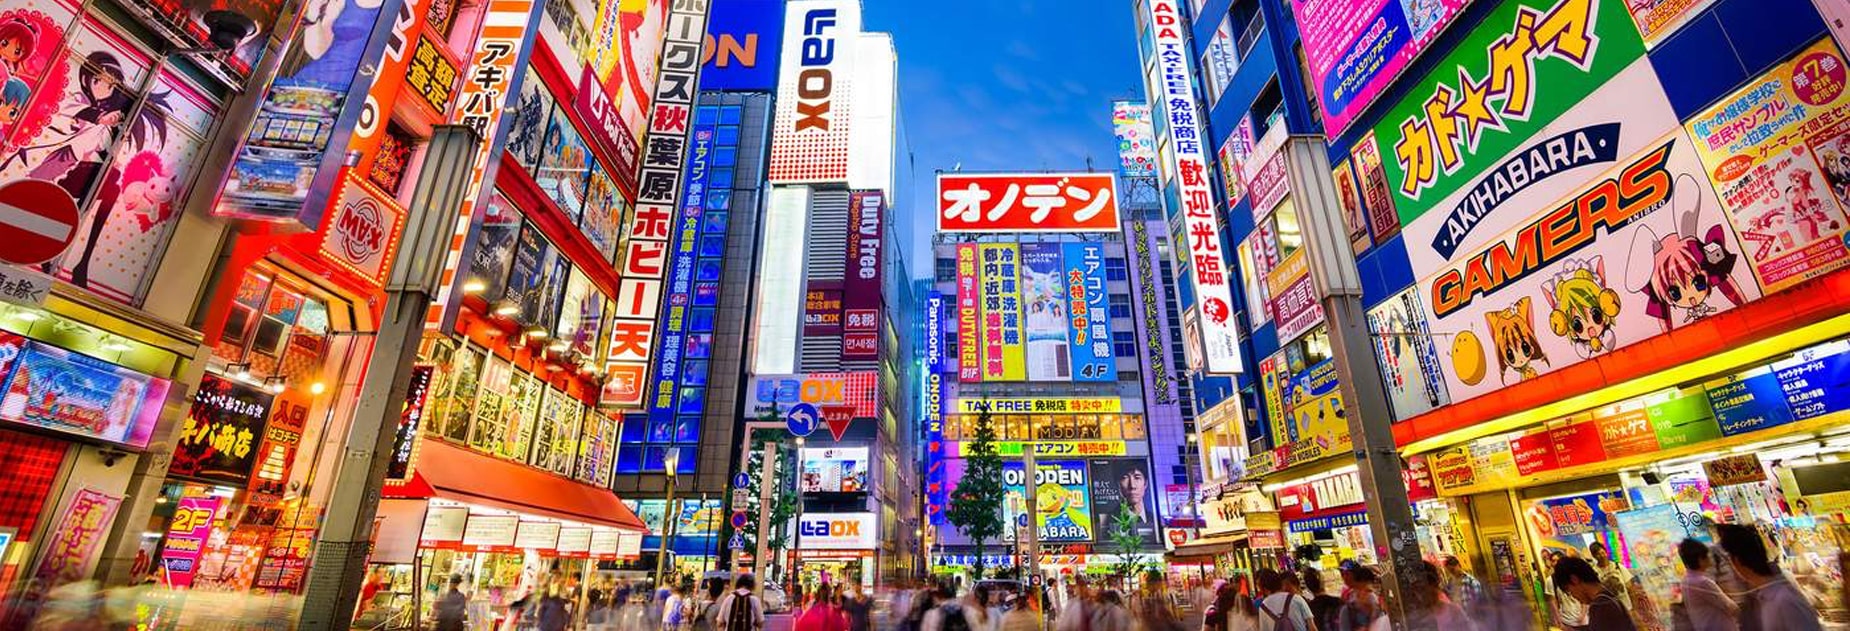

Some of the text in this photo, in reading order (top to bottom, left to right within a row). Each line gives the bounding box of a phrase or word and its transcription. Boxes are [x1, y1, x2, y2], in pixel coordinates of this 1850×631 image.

[1170, 98, 1199, 155] 免税商店
[943, 177, 1111, 224] オノデン
[1449, 131, 1596, 246] AKIHABARA
[859, 196, 882, 279] Duty Free
[1180, 159, 1224, 287] 歓迎光臨
[1431, 140, 1676, 316] GAMERS
[930, 298, 941, 365] Panasonic
[1081, 364, 1108, 378] 4F
[273, 400, 307, 429] 入口
[931, 373, 940, 432] ONODEN
[965, 401, 992, 411] TAX
[996, 401, 1032, 411] FREE
[1035, 400, 1066, 411] 免税店
[1035, 443, 1073, 453] エアコン
[170, 508, 211, 532] 2F
[1007, 526, 1088, 538] AABARA
